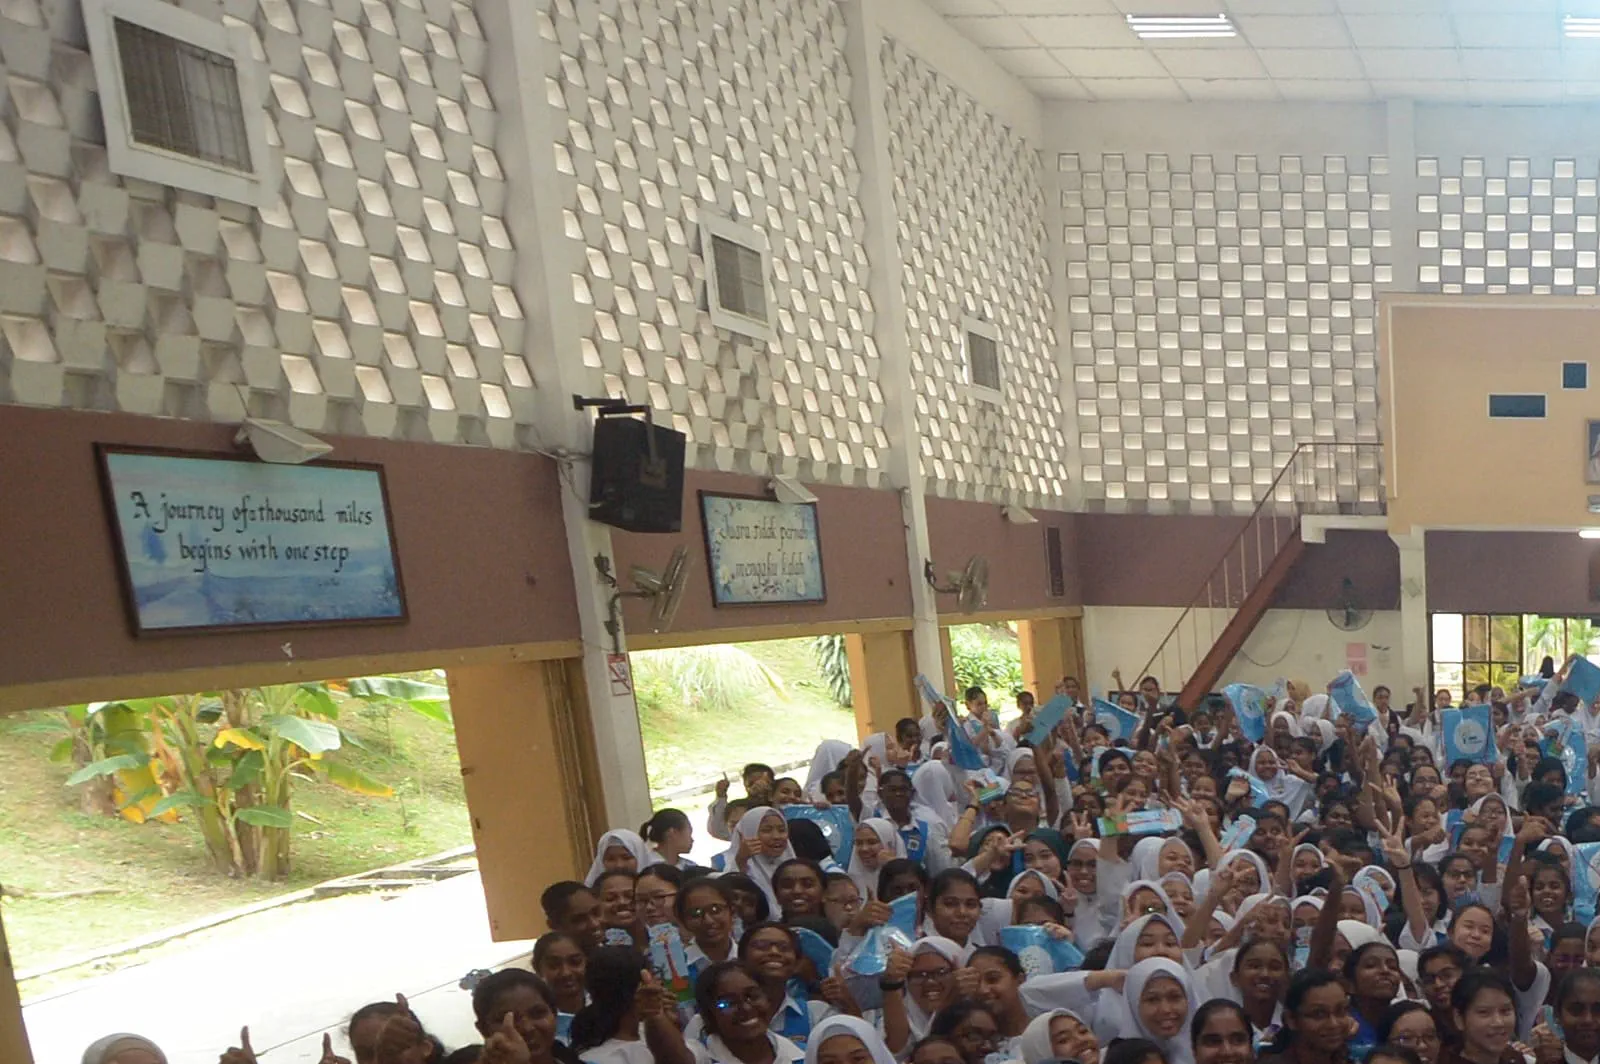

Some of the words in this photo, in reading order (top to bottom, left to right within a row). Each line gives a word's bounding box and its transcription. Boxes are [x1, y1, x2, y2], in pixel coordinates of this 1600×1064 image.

[131, 491, 151, 519] A
[152, 493, 225, 533] journey
[232, 495, 251, 534] of
[257, 496, 326, 523] thousand
[335, 500, 373, 525] miles
[178, 533, 232, 572] begins
[237, 534, 279, 561] with
[284, 545, 309, 561] one
[313, 545, 349, 573] step
